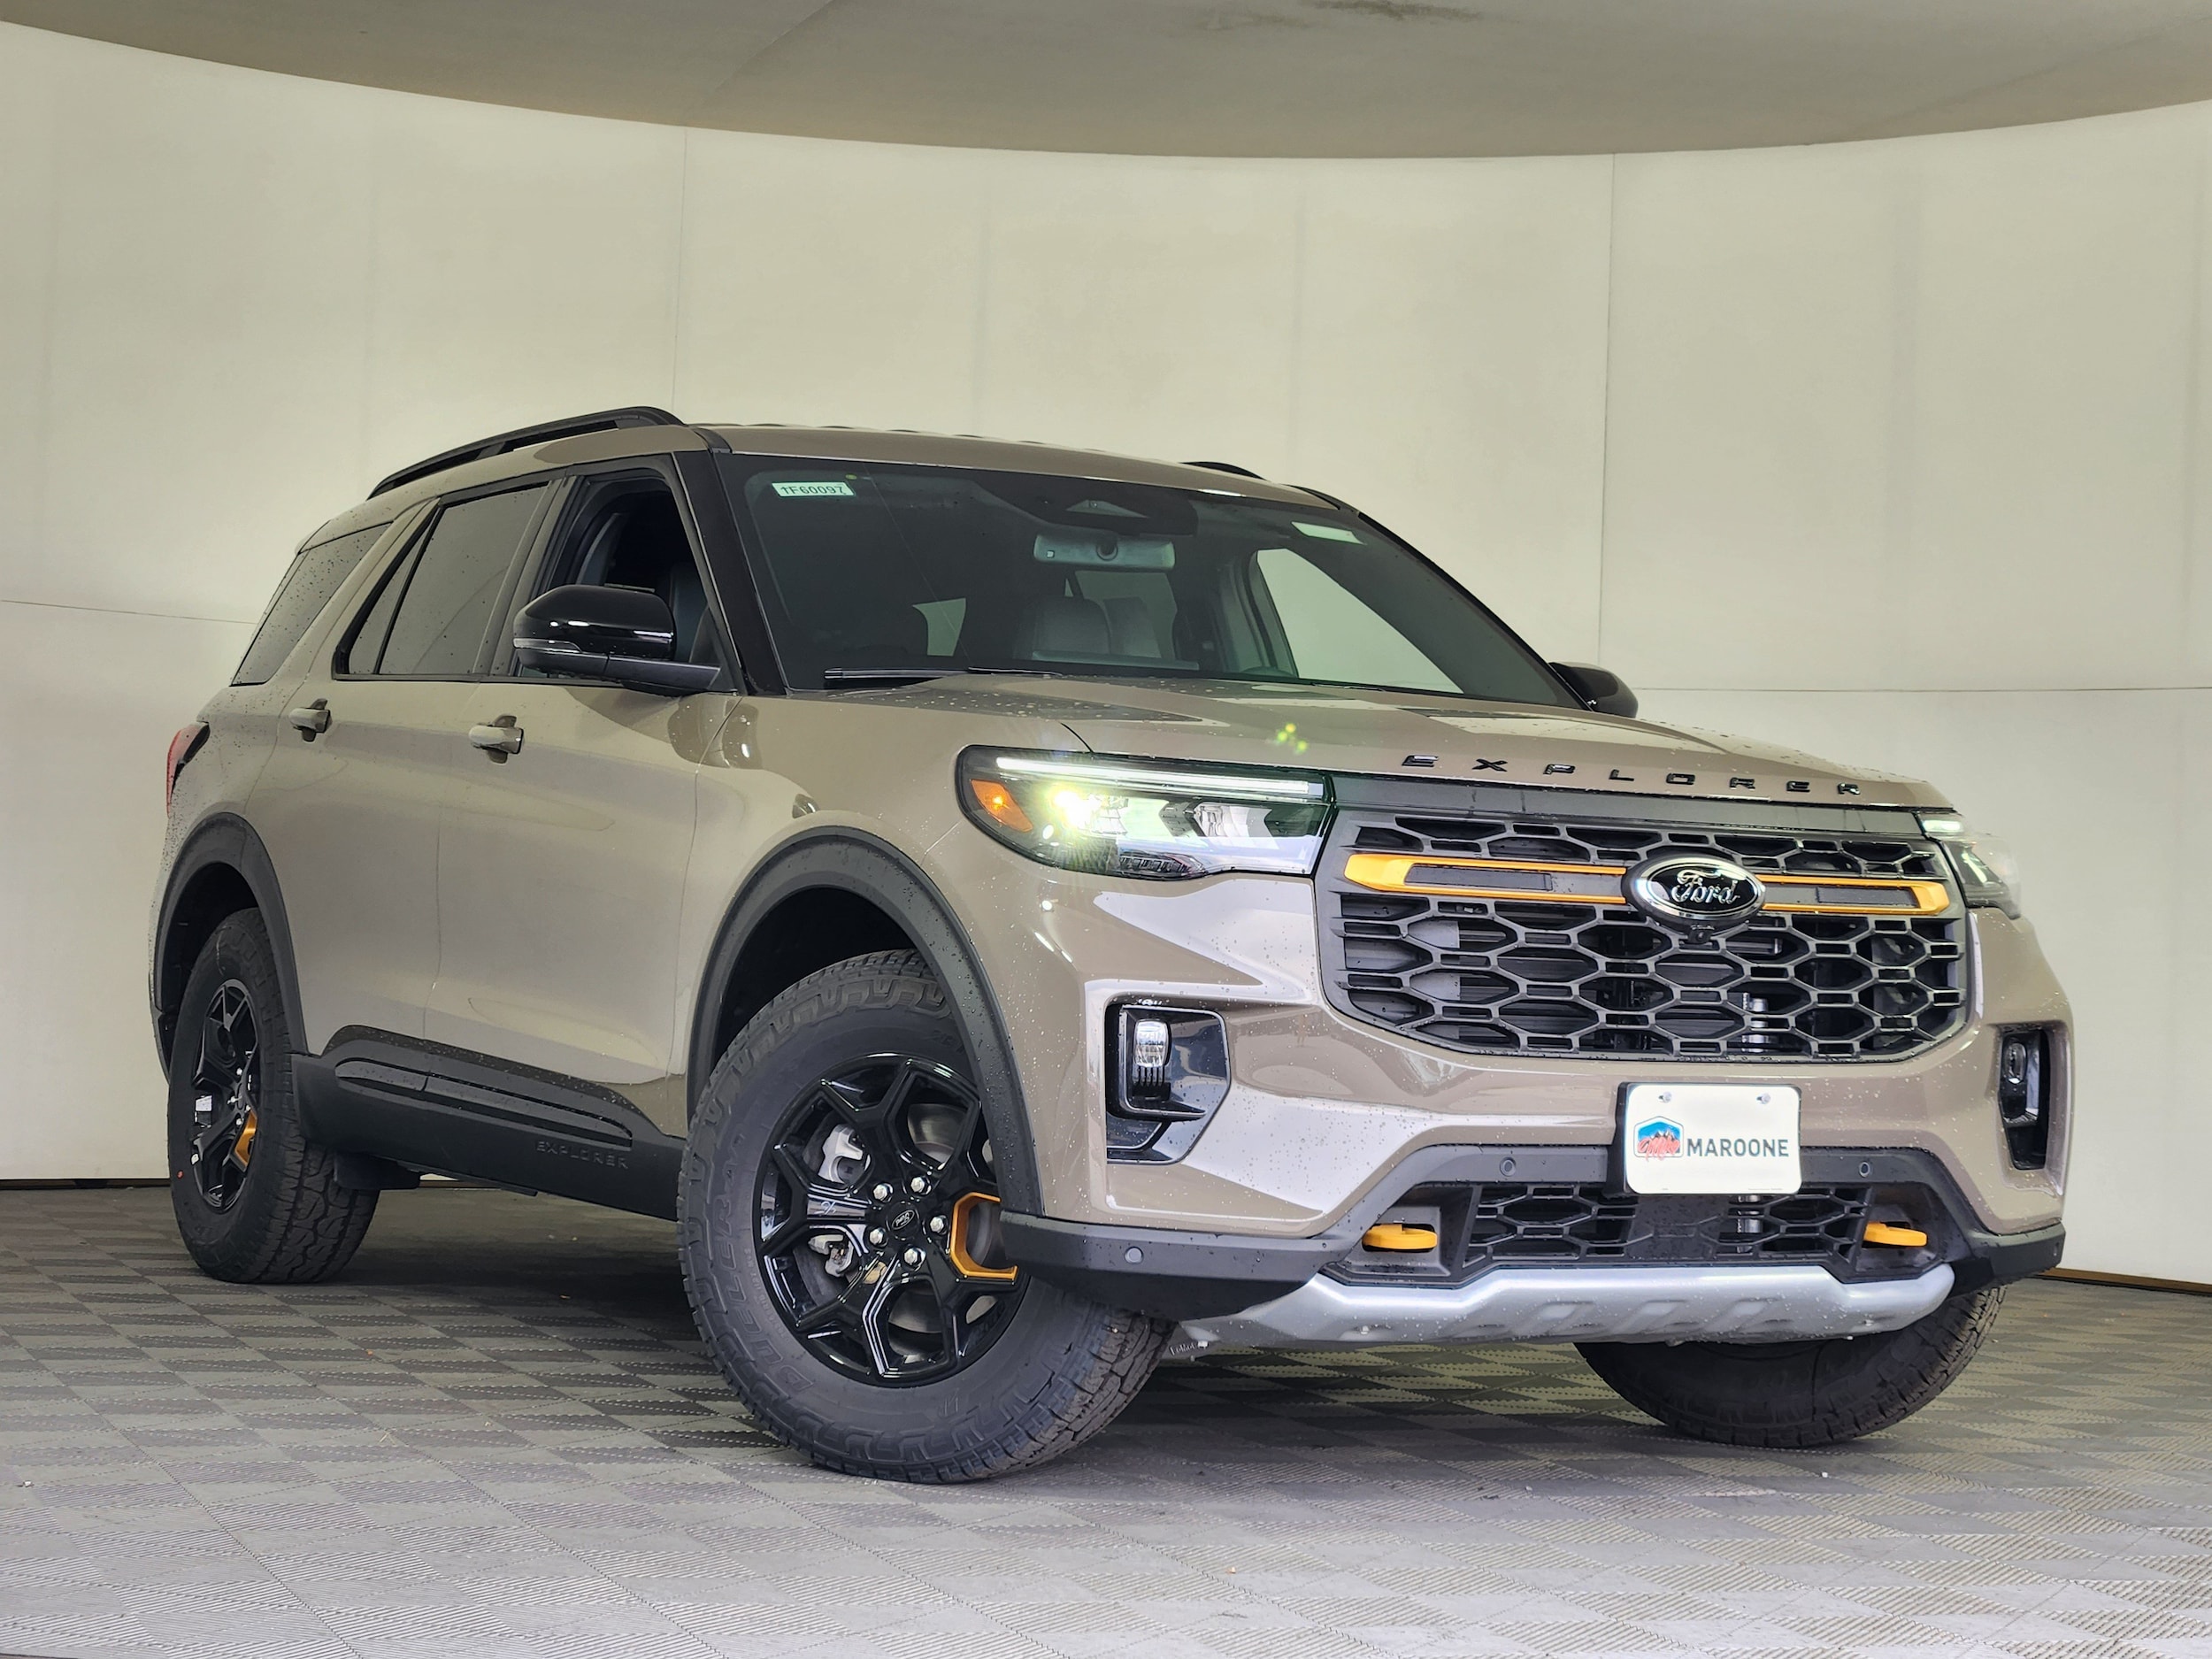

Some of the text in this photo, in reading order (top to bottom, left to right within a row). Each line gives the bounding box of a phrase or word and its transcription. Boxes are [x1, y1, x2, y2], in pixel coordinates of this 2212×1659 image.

[1402, 755, 1861, 795] EXPLORER
[1671, 869, 1740, 904] Ford
[536, 1141, 629, 1169] EXPLORER
[1686, 1138, 1789, 1157] MAROONE
